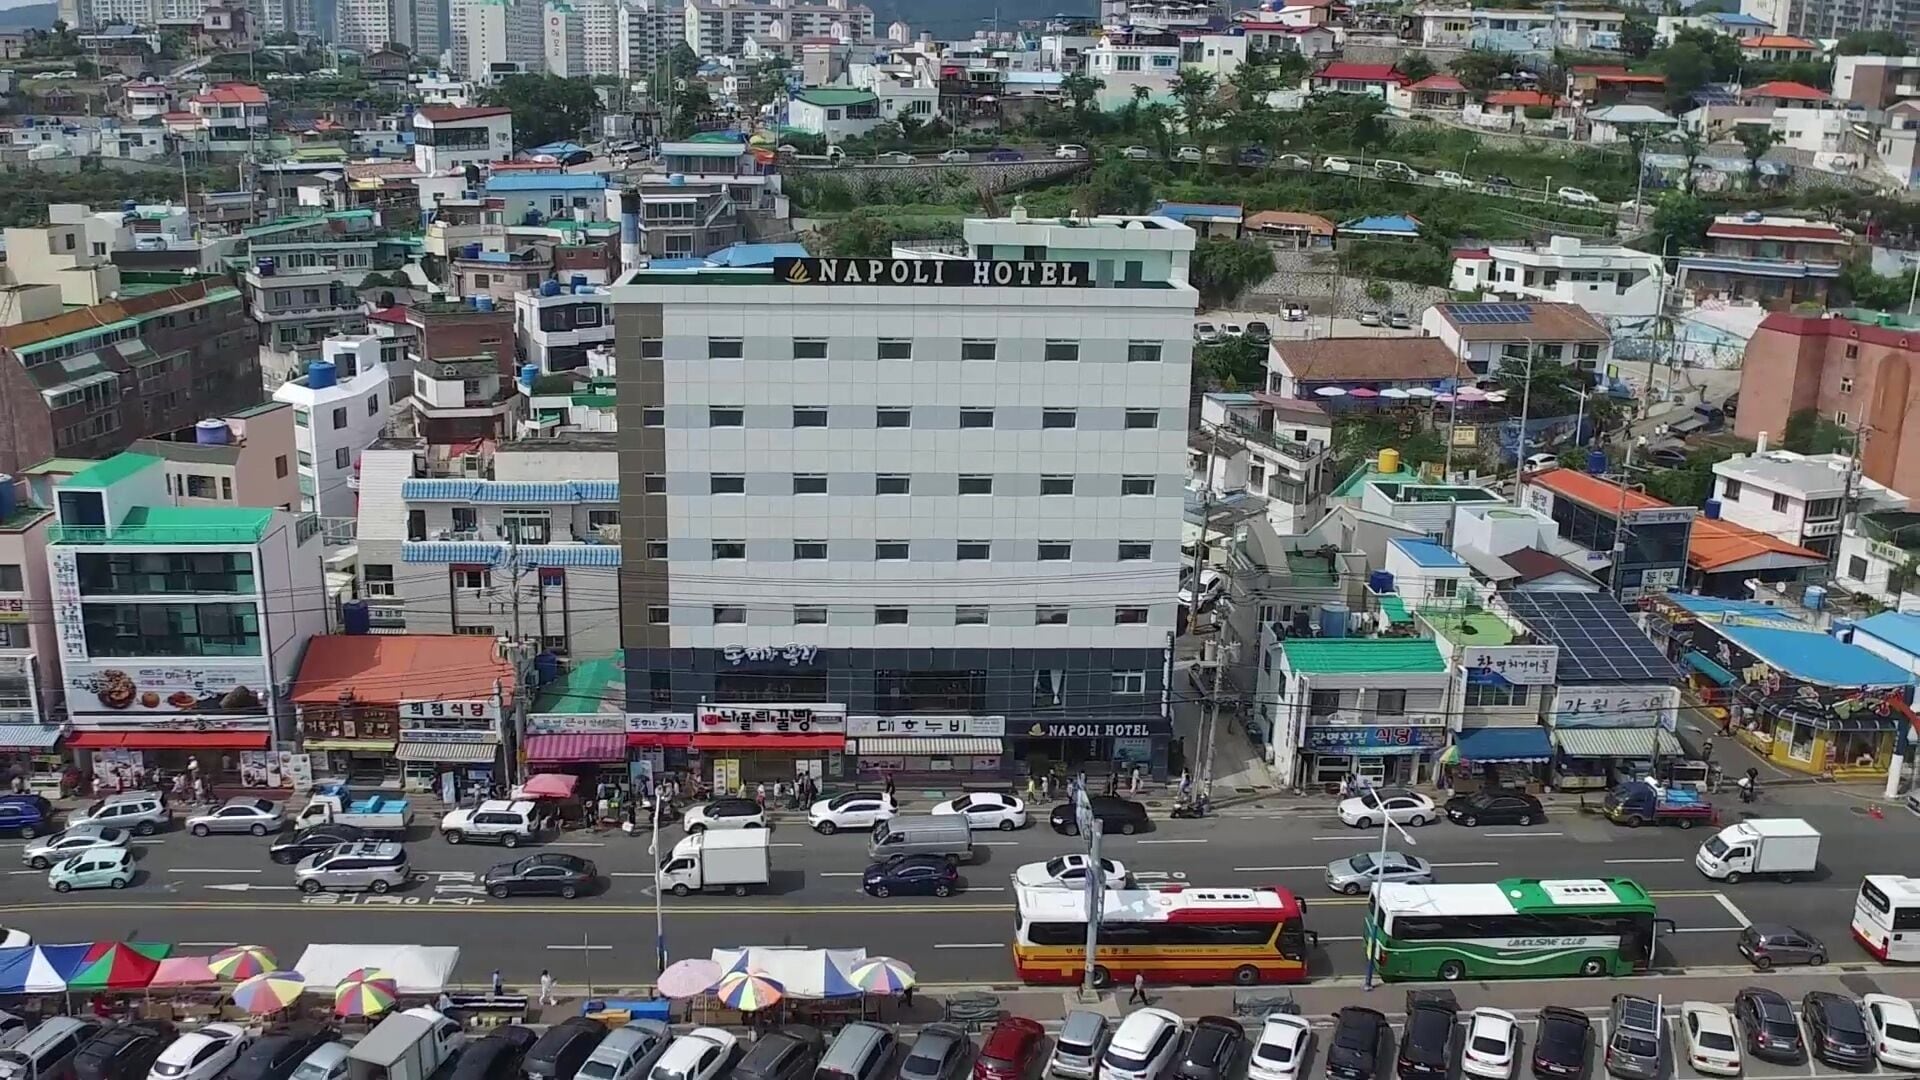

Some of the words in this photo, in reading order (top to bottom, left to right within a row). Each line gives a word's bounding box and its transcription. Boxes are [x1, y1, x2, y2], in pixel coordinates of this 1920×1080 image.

[818, 258, 945, 284] NAPOLI
[973, 261, 1078, 285] HOTEL
[1477, 654, 1494, 676] 참
[877, 719, 967, 733] 대호누비
[1049, 724, 1100, 737] NAPOLI
[1105, 724, 1149, 737] HOTEL
[1311, 731, 1368, 745] 광명횟집
[1374, 727, 1413, 745] 식당
[1507, 938, 1558, 947] LIMOUSINE
[1560, 937, 1588, 946] CLUB
